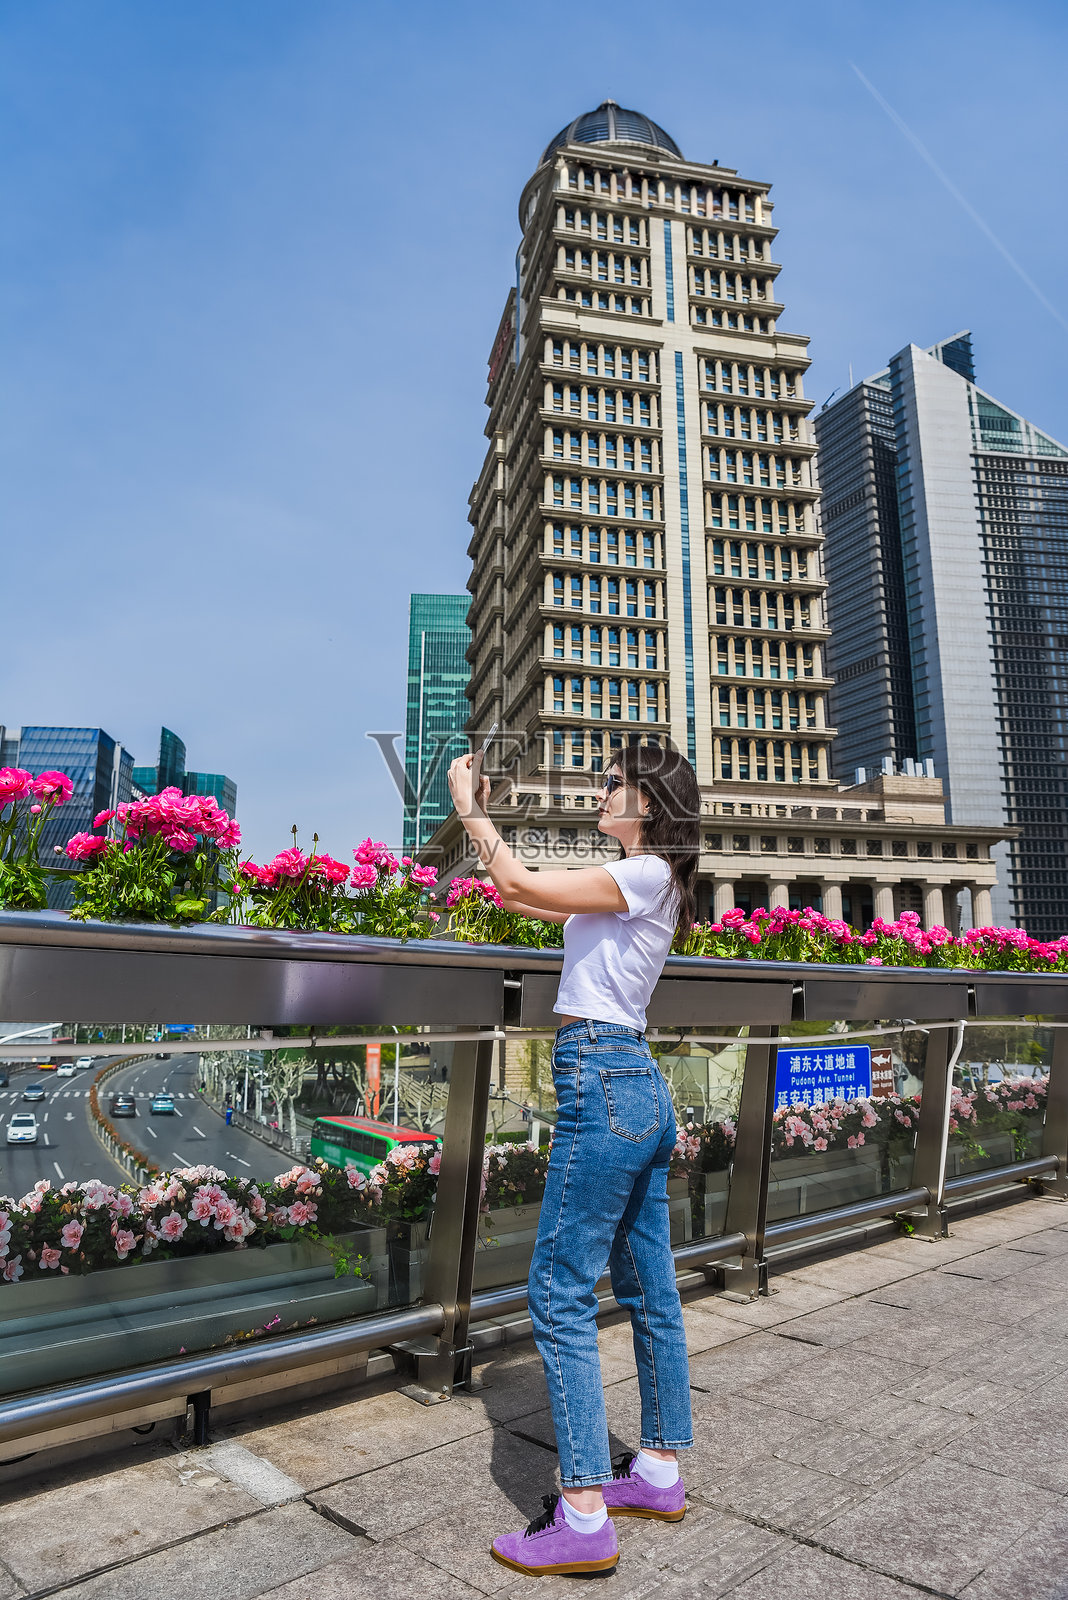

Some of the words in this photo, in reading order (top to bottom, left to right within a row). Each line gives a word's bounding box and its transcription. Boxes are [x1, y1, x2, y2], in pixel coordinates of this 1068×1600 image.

[790, 1053, 856, 1073] 浦东大道地道
[791, 1076, 816, 1087] Pudong
[818, 1074, 832, 1083] Ave.
[834, 1073, 855, 1083] Tunnel
